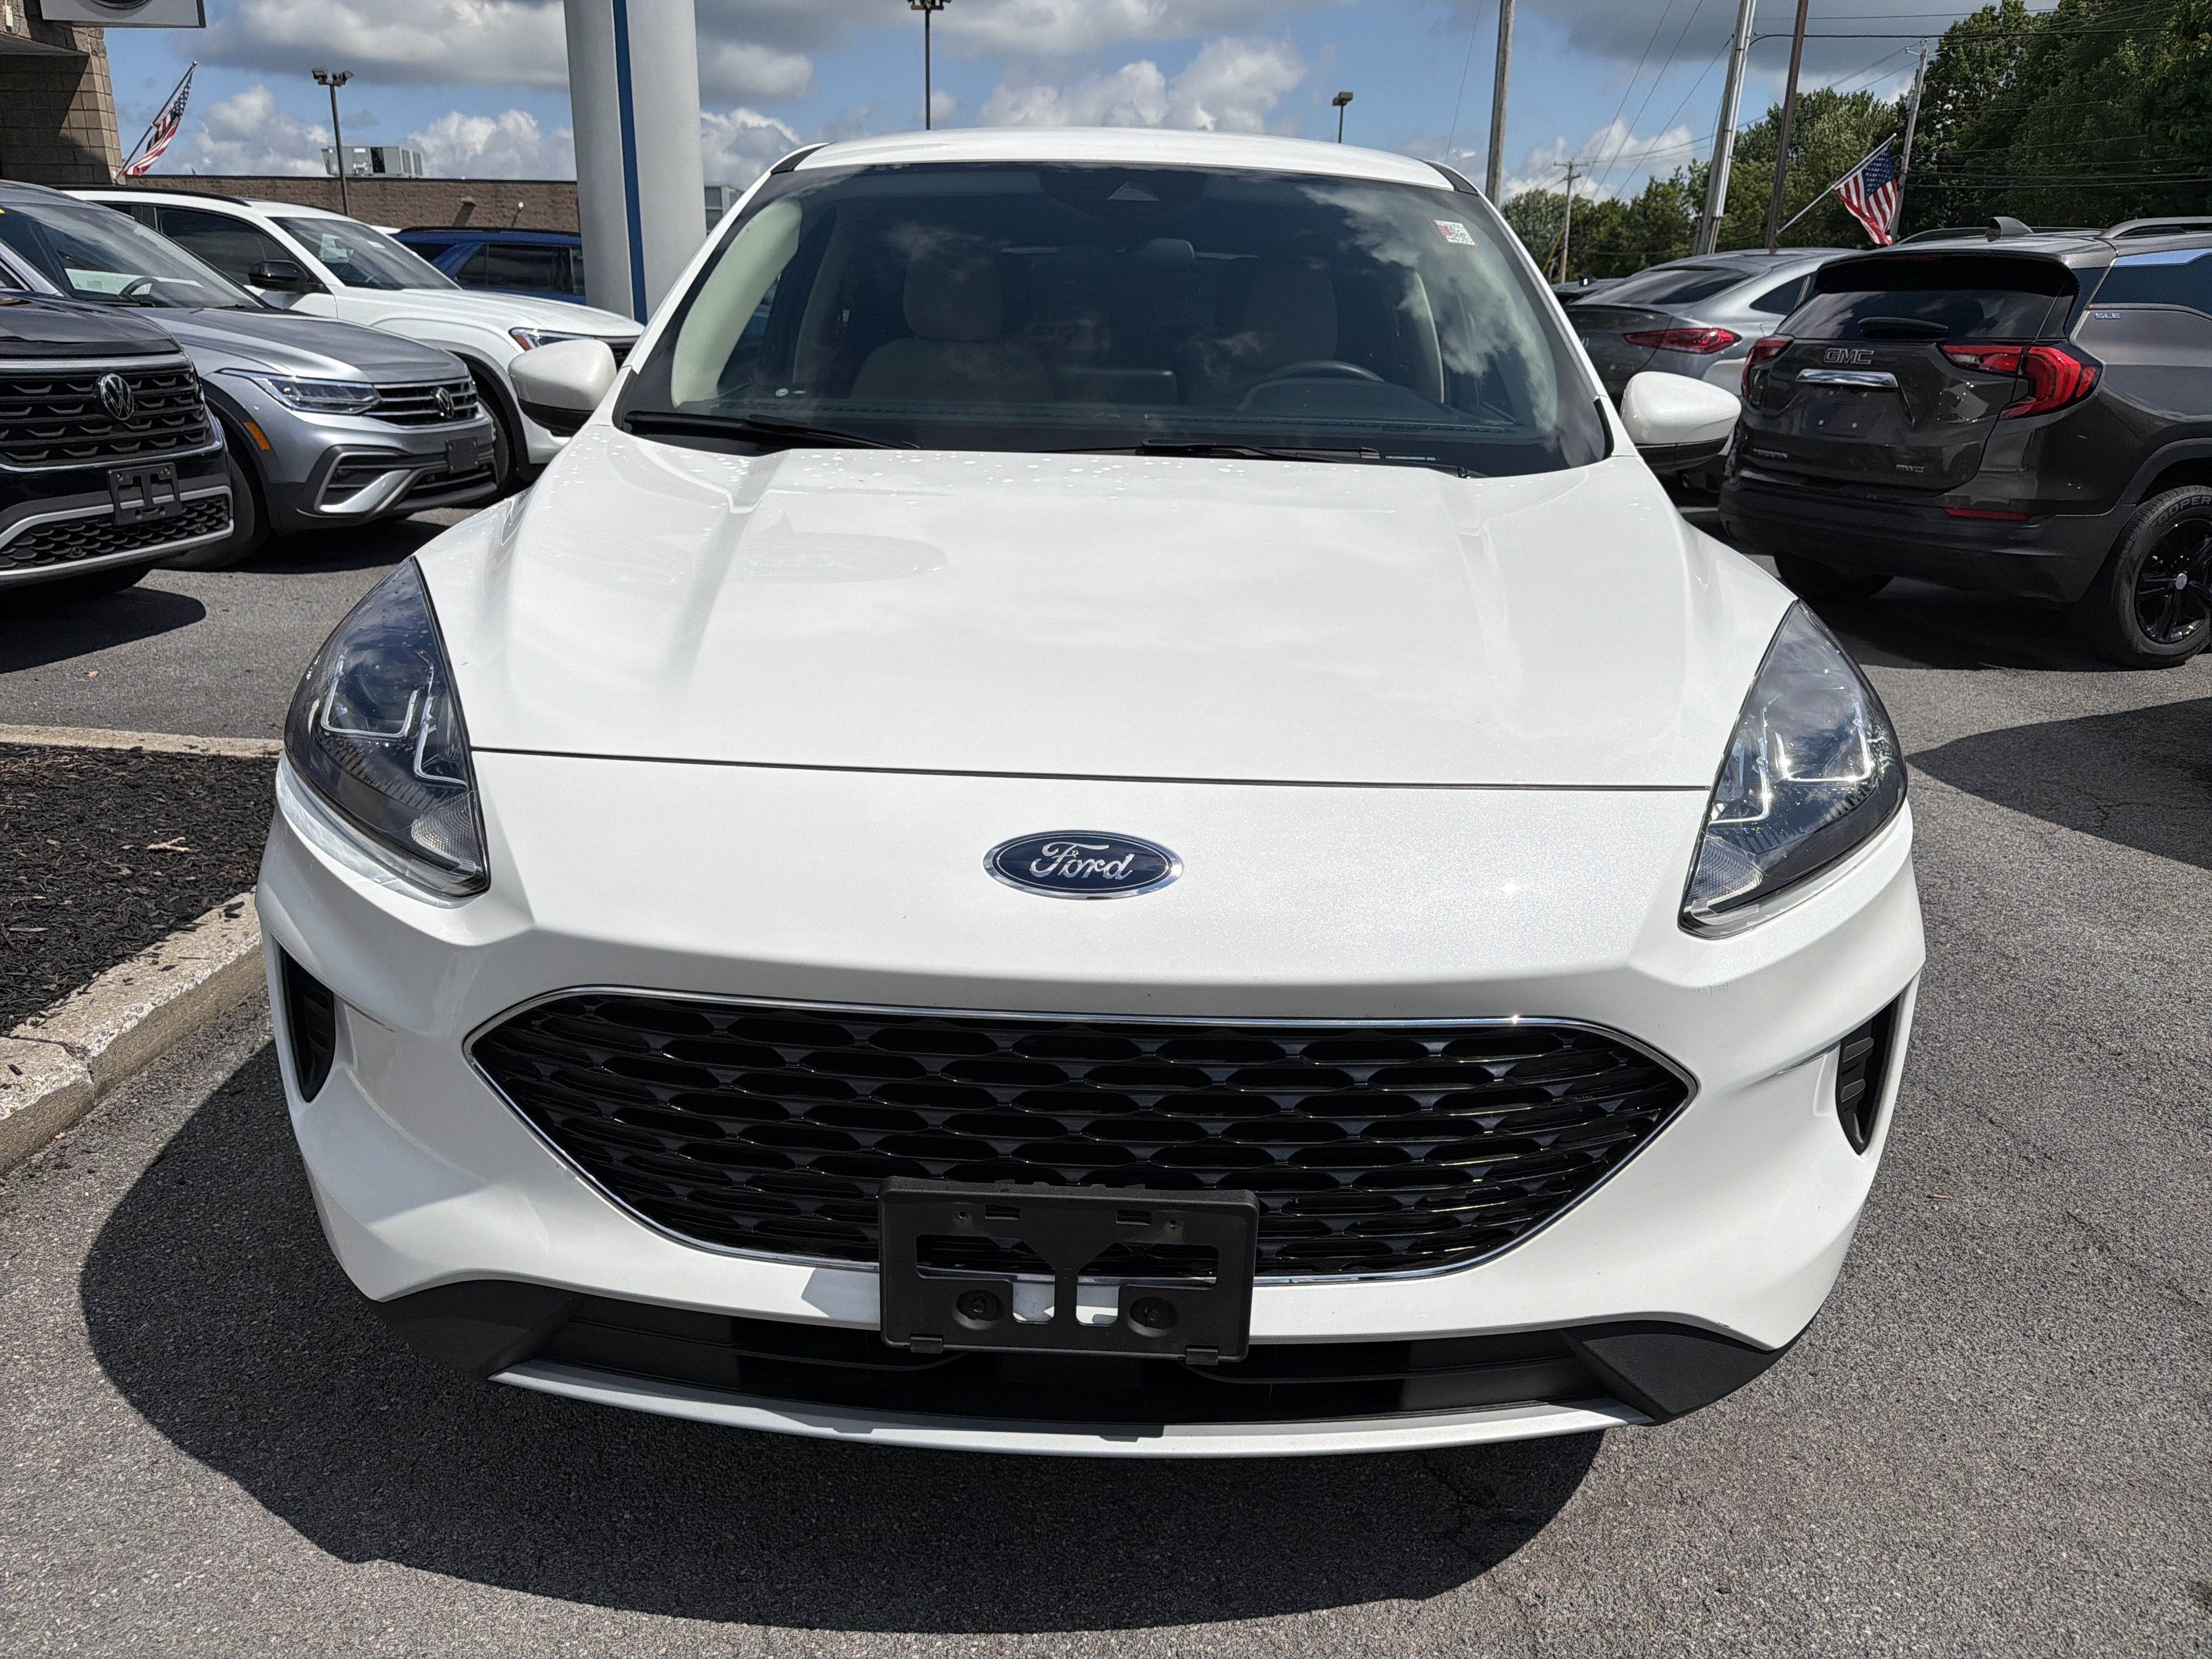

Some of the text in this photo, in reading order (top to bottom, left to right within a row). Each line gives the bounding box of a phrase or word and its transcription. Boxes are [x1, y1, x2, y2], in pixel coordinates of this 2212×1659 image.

[1824, 348, 1875, 365] GMC
[2150, 495, 2211, 529] OOPER
[1029, 842, 1136, 880] Ford
